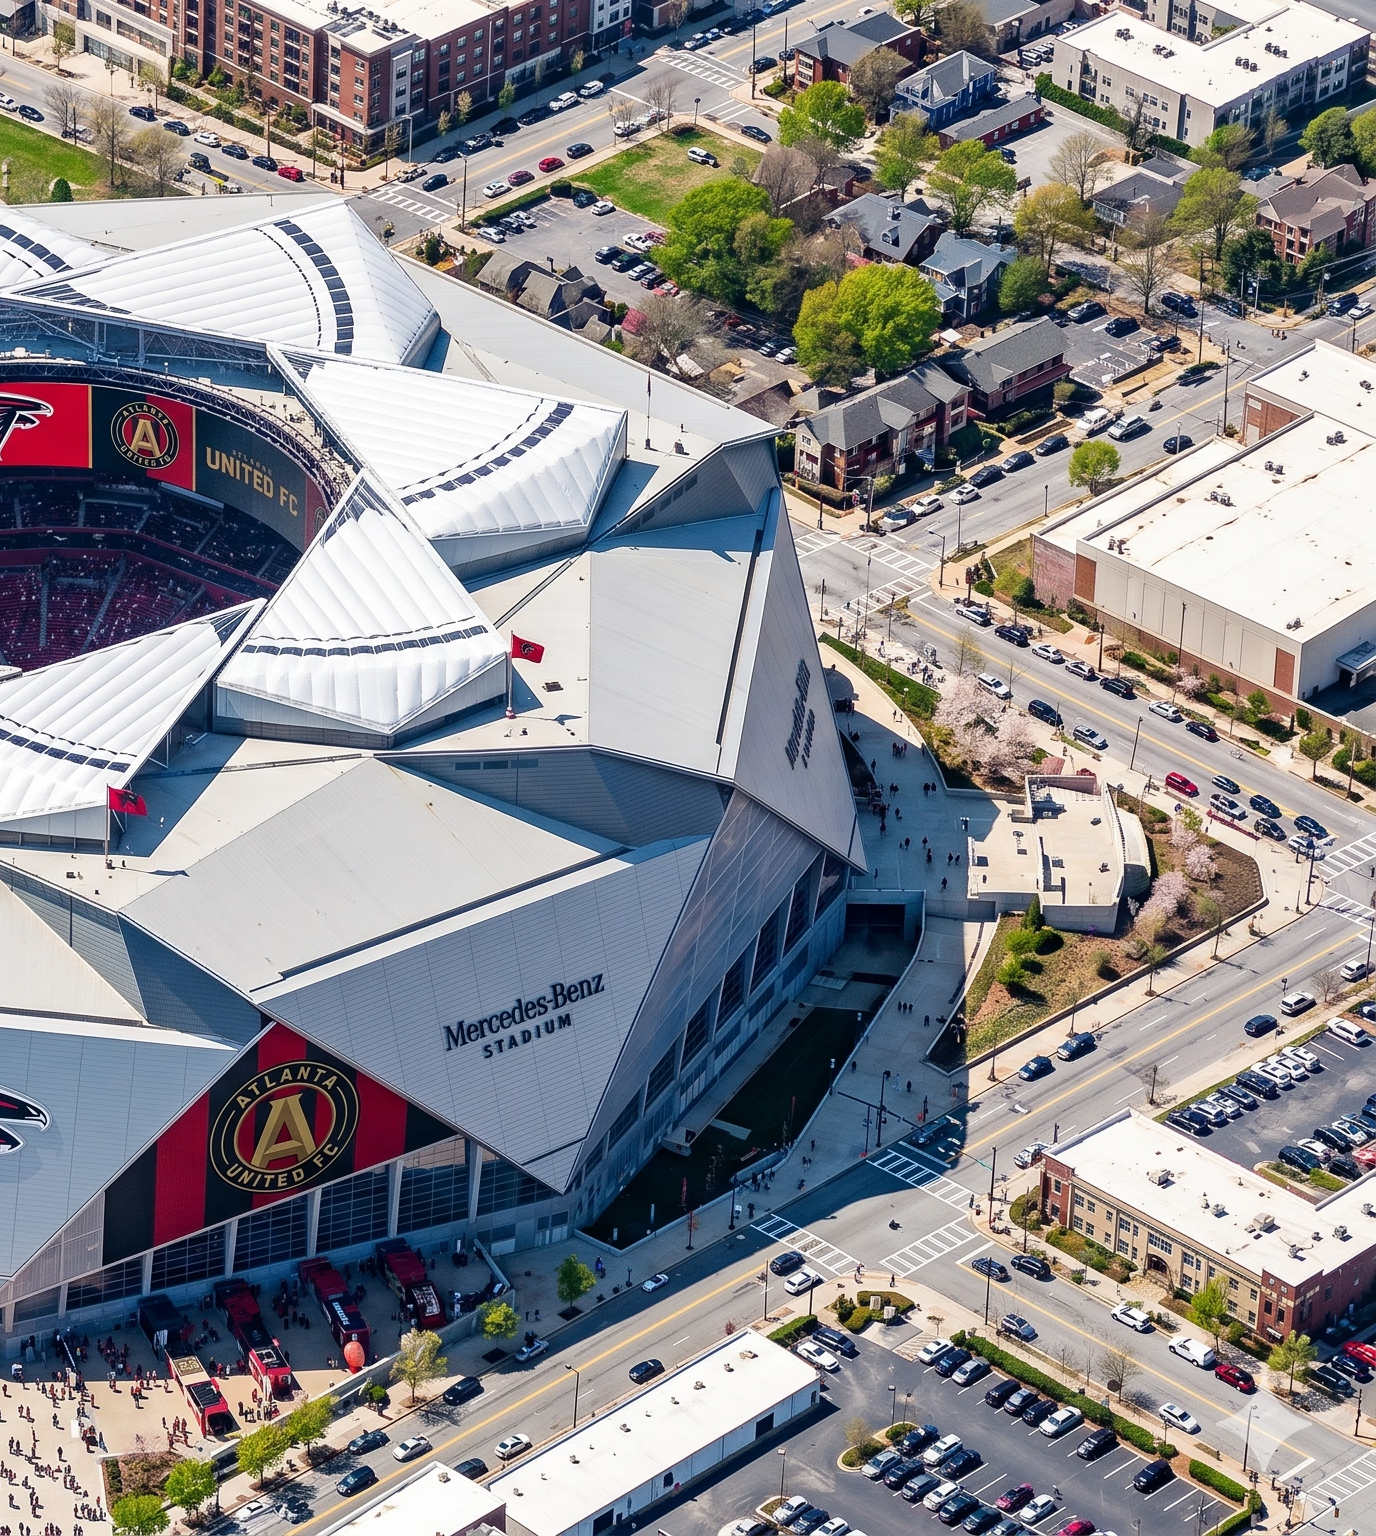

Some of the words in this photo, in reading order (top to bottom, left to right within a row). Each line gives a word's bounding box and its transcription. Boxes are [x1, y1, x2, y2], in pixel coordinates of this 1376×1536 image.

[130, 418, 161, 458] A
[205, 446, 274, 499] UNITED
[279, 485, 298, 517] FC
[442, 973, 605, 1051] Mercedes-Benz
[482, 1013, 572, 1059] STADIUM
[236, 1066, 338, 1109] ATLANTA
[250, 1092, 317, 1169] A
[226, 1163, 305, 1188] UNITED
[312, 1143, 339, 1168] FC
